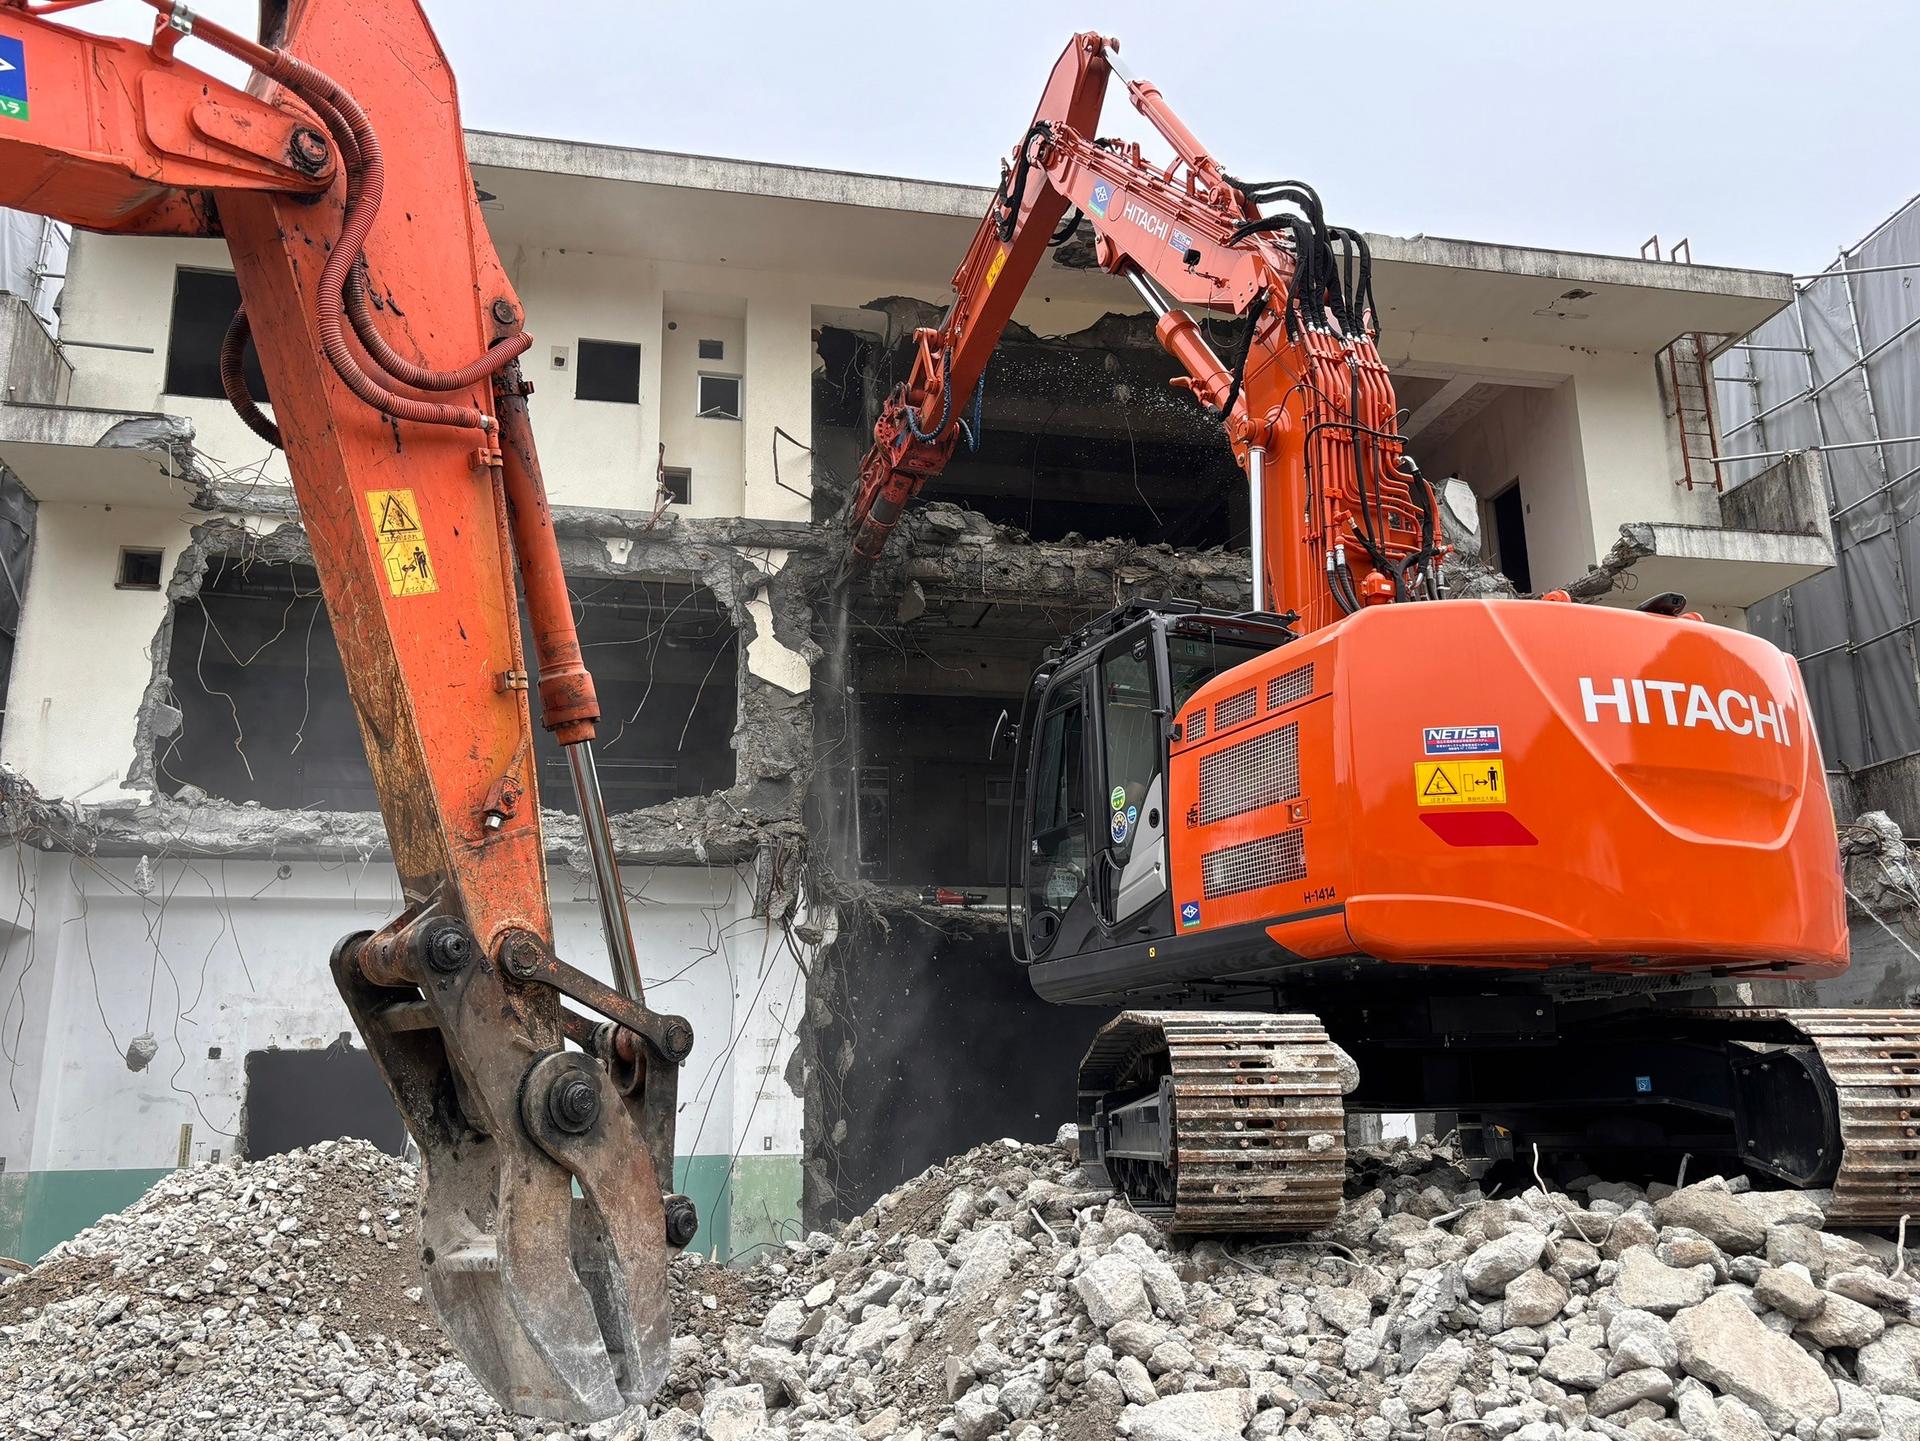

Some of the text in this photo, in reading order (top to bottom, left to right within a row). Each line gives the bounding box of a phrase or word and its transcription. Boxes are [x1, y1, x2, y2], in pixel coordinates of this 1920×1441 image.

[1124, 201, 1169, 241] HITACHI
[1578, 677, 1791, 747] HITACHI
[1428, 728, 1478, 740] NETIS
[1303, 885, 1336, 905] H-1414
